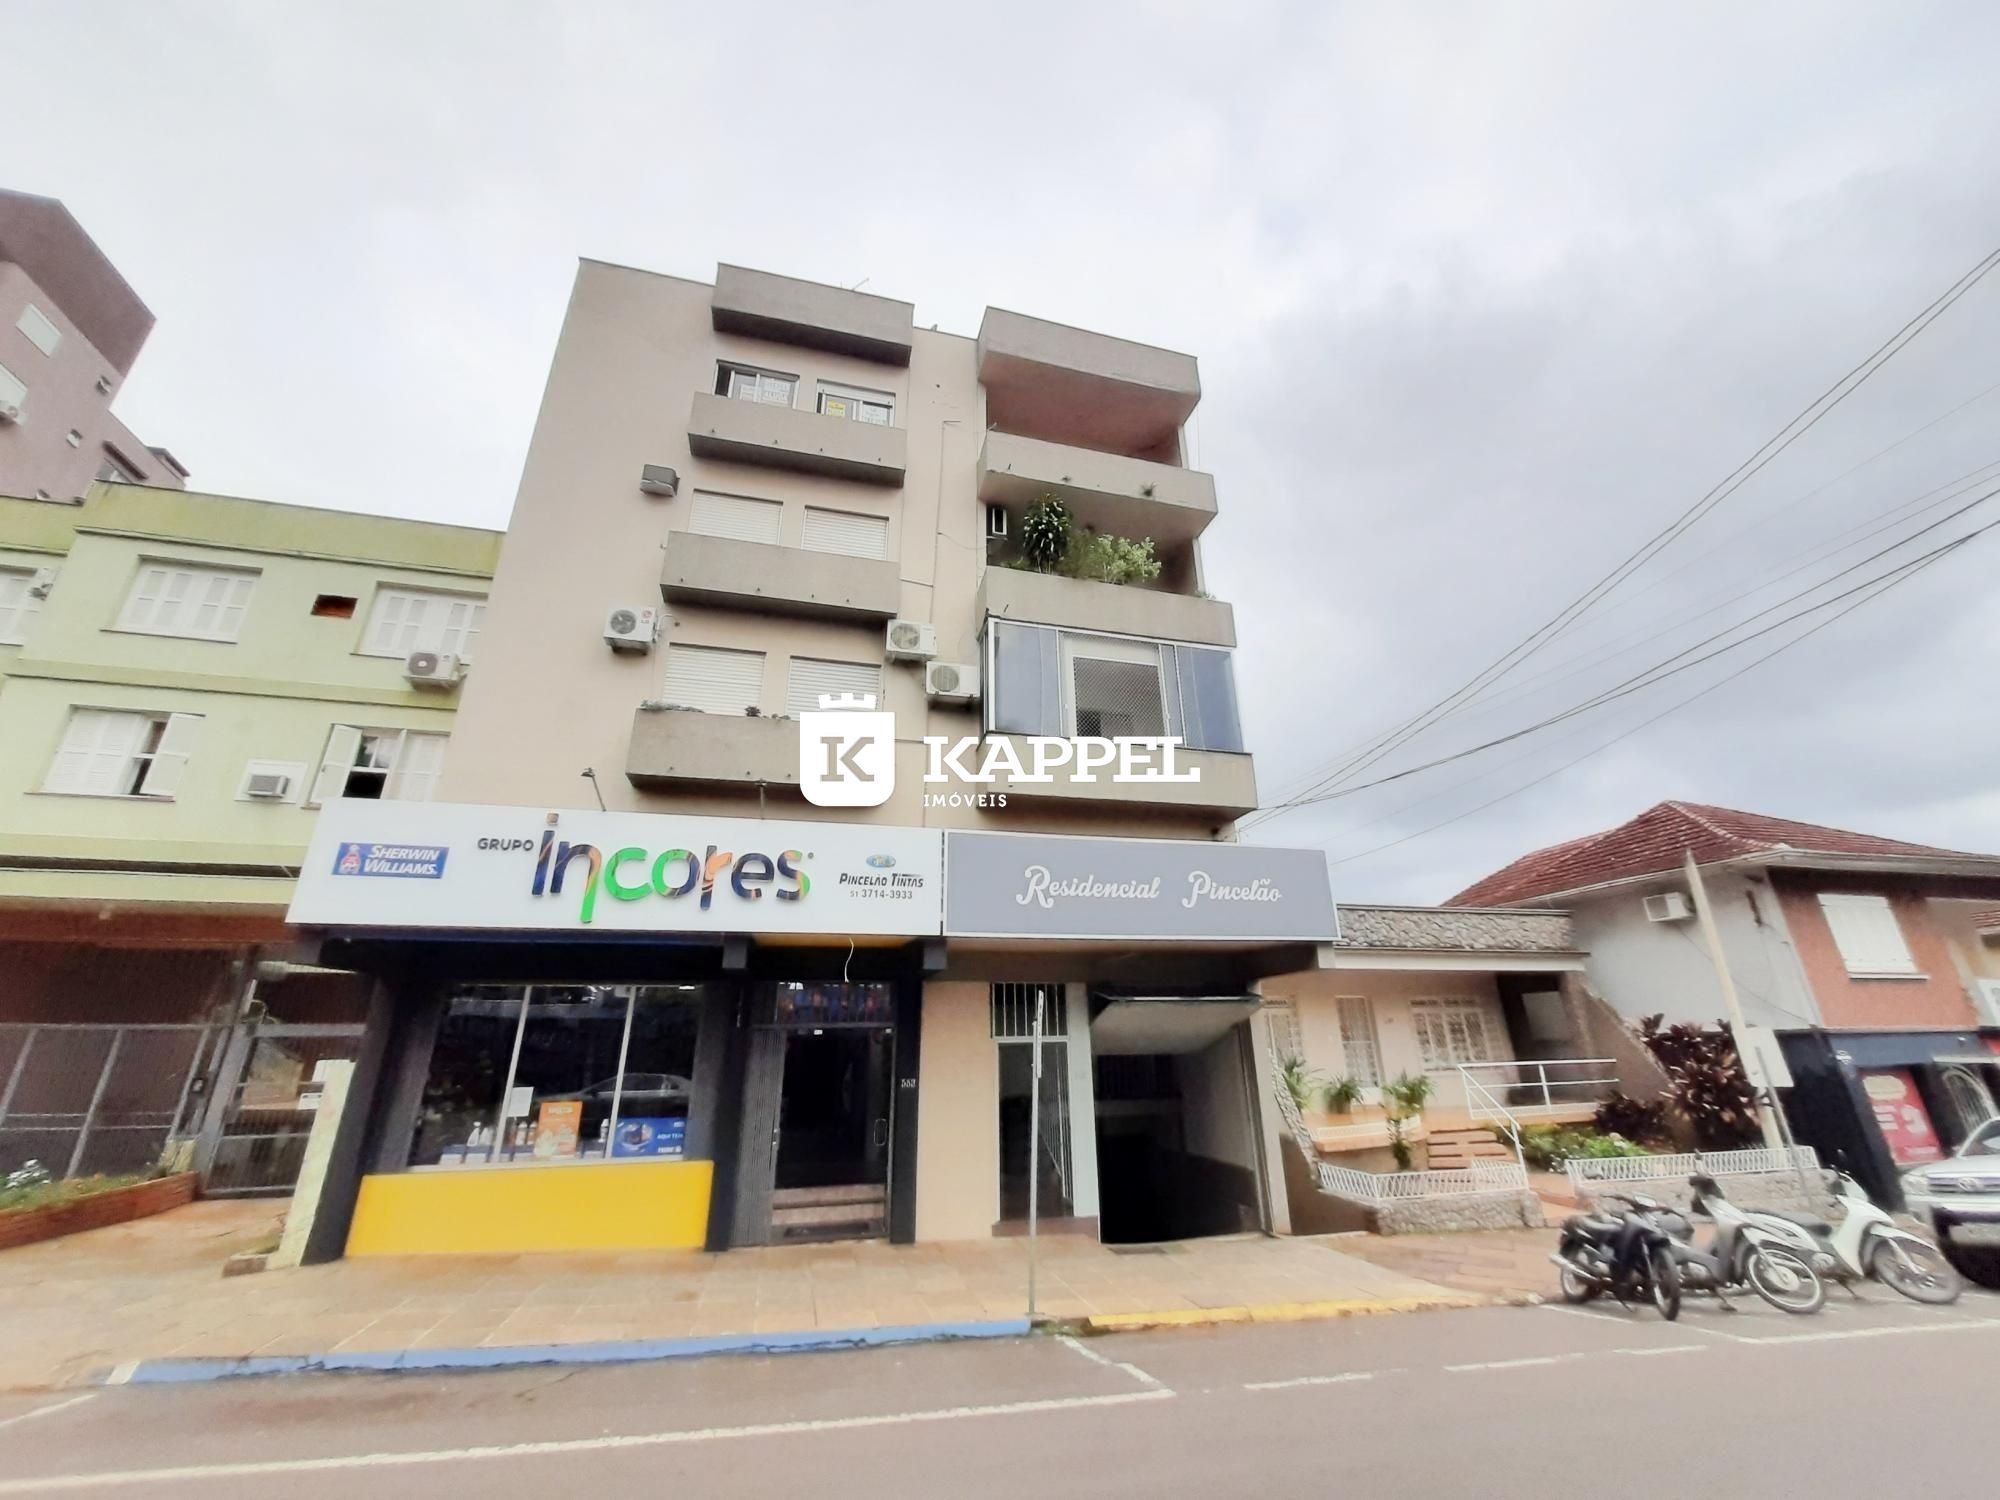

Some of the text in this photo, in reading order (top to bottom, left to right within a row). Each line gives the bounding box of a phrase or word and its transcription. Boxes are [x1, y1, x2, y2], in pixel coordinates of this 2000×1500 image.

[477, 837, 534, 851] GRUPO
[368, 845, 440, 860] SHERWIN
[531, 812, 811, 924] incores
[891, 872, 925, 888] TINTAS
[1016, 865, 1281, 908] Residencial Pincelão
[861, 889, 913, 899] 3714-3933
